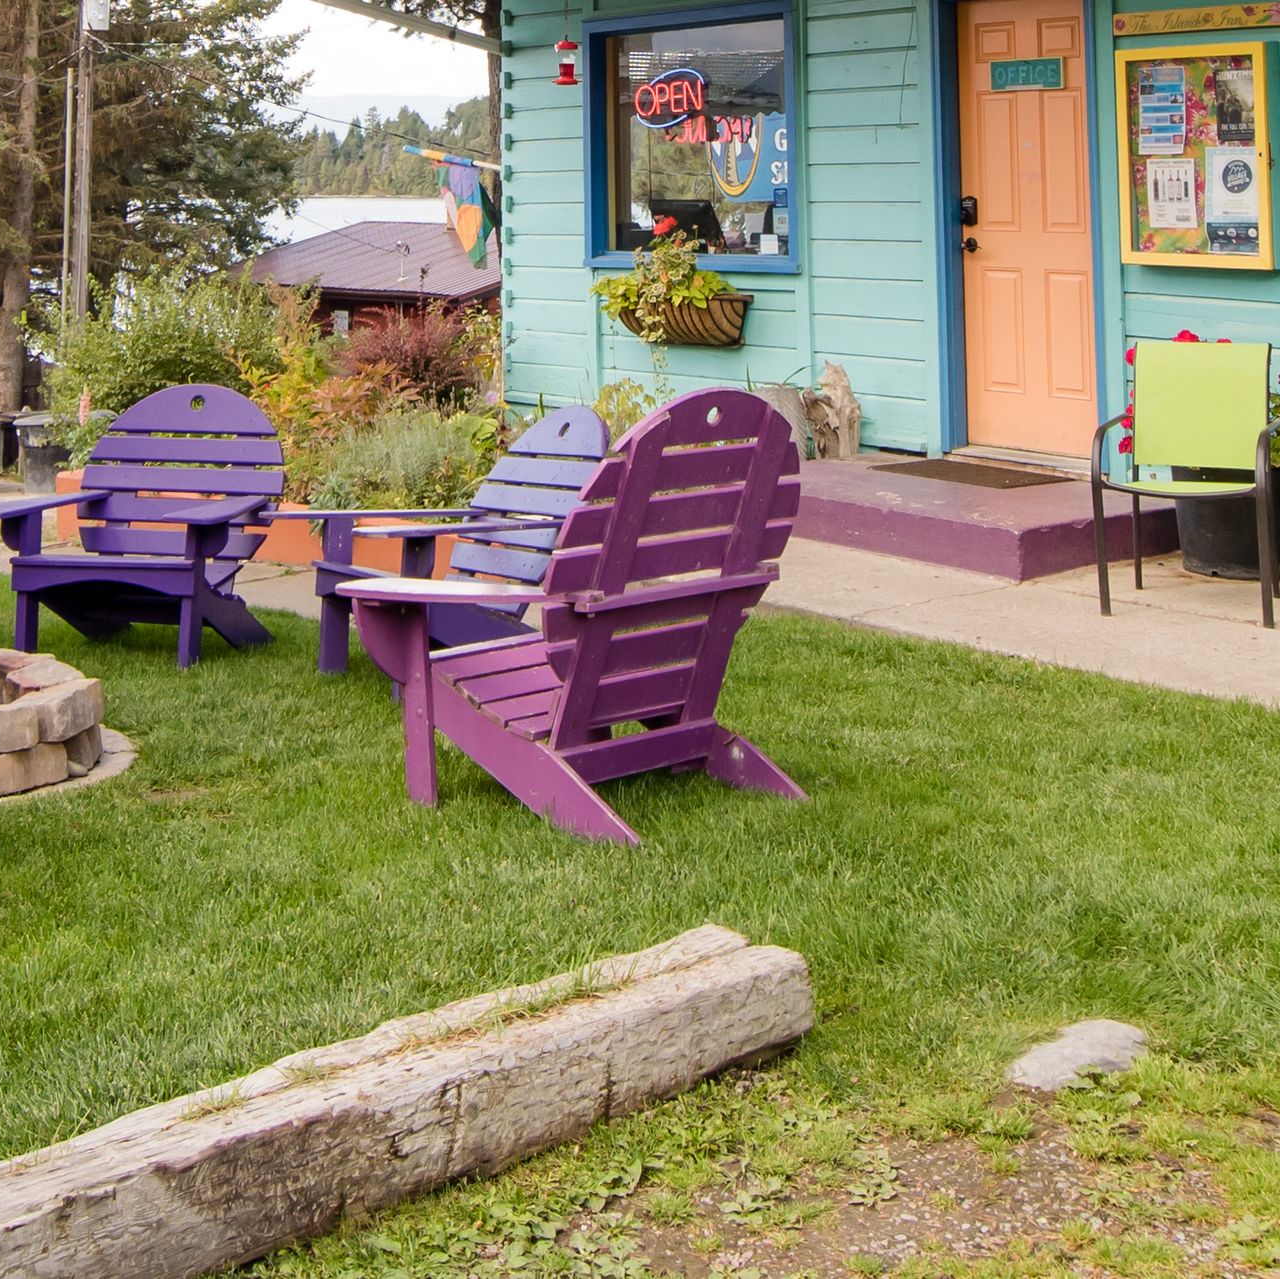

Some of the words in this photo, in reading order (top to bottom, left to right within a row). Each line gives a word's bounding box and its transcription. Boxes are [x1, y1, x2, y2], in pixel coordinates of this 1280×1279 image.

[1156, 11, 1201, 31] Island
[1212, 7, 1244, 27] Inn
[995, 64, 1057, 84] OFFICE
[634, 79, 703, 117] OPEN
